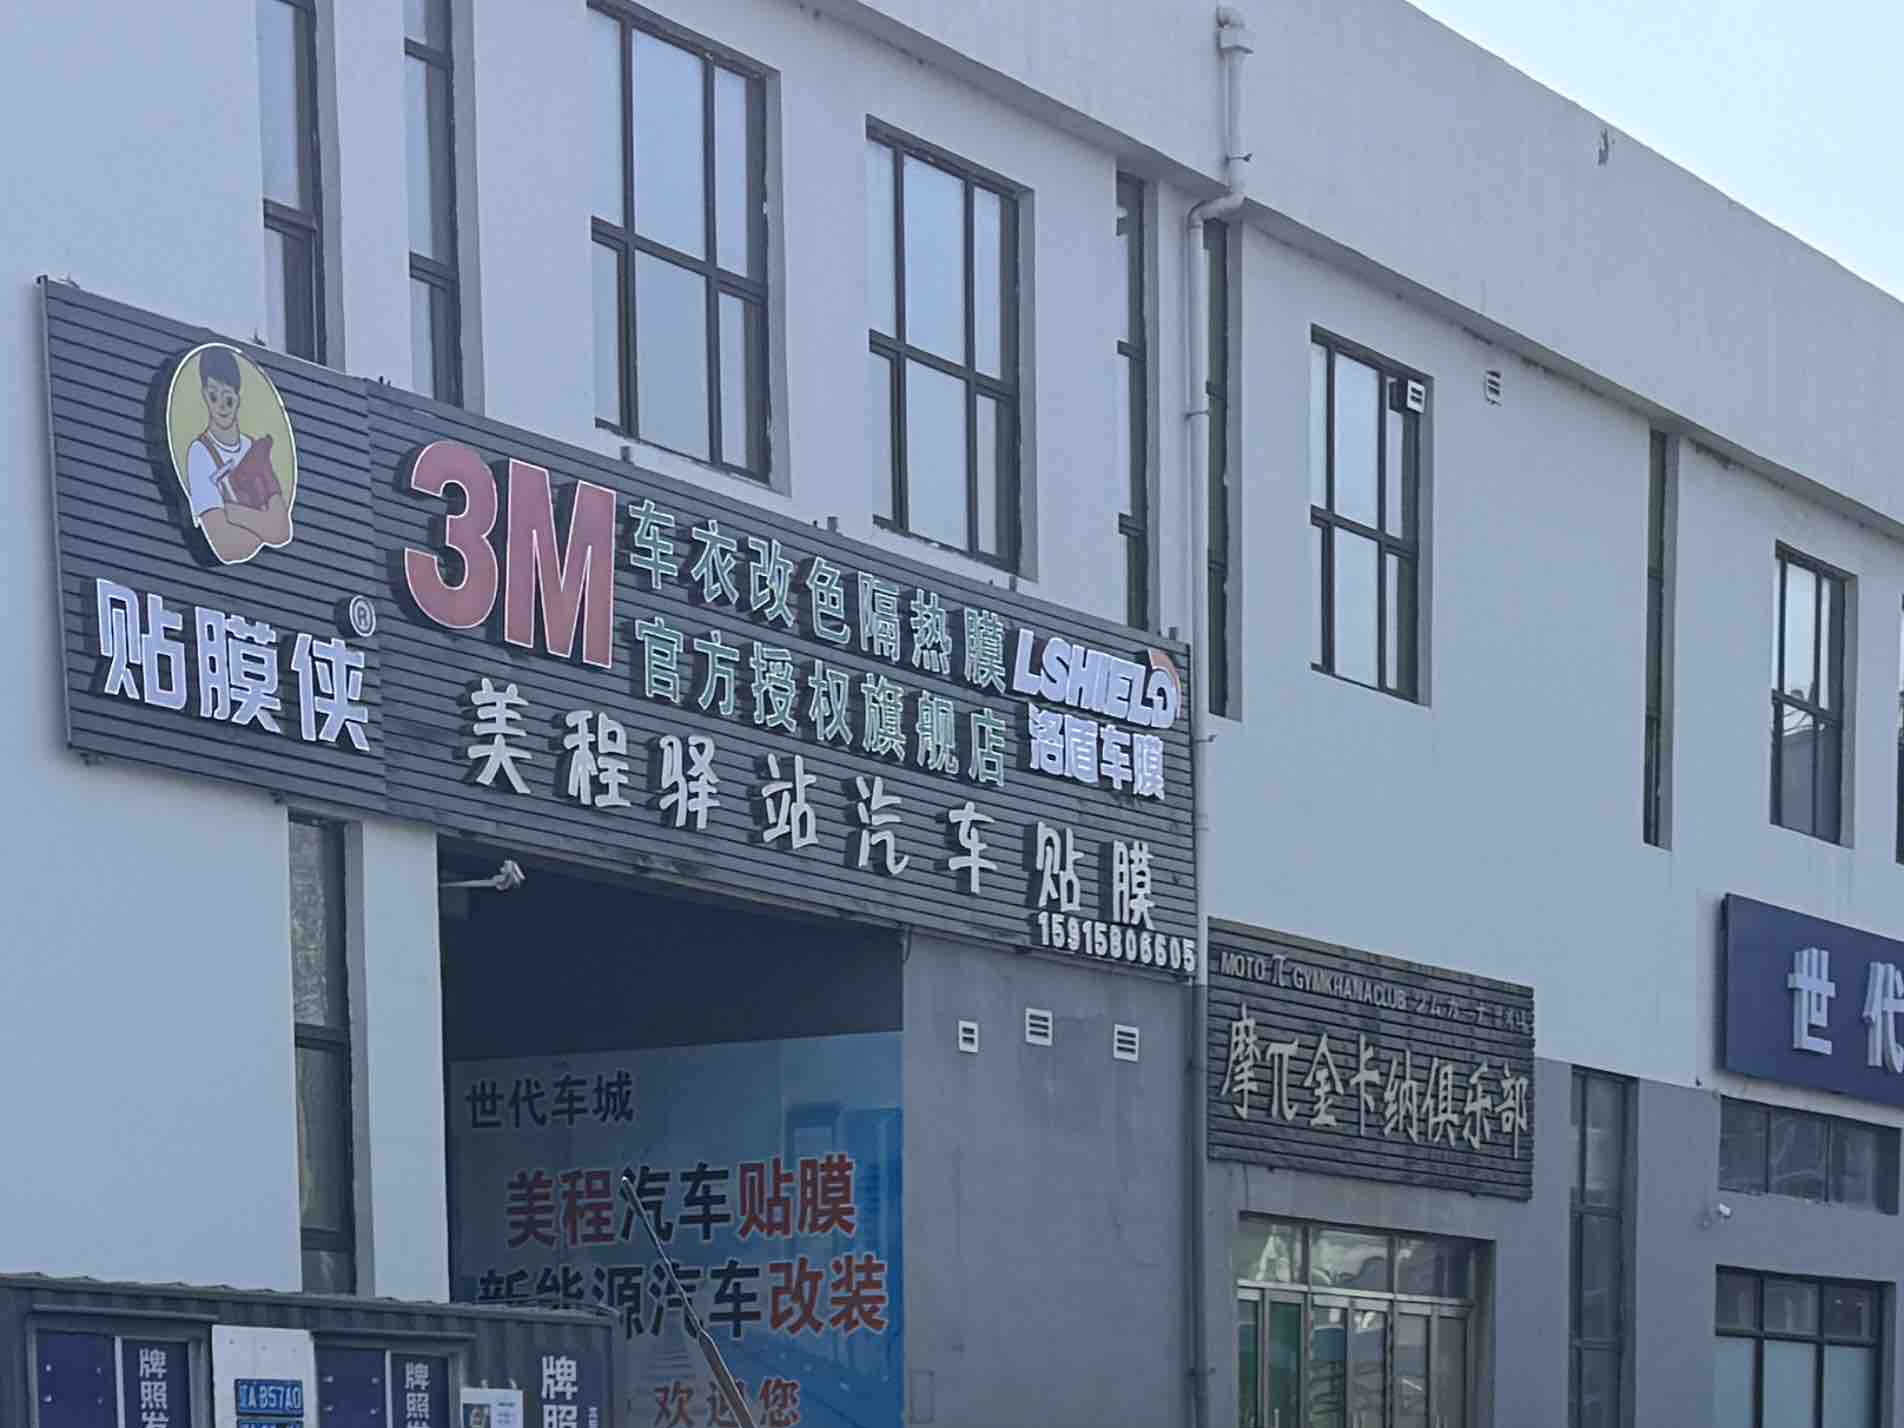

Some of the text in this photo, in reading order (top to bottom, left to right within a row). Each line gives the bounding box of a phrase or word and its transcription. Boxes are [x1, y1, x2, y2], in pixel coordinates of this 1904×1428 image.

[403, 440, 619, 669] 3M
[628, 499, 1007, 695] 车衣改色隔热膜
[96, 578, 371, 752] 贴膜侠
[636, 616, 1006, 787] 官方授权旗舰店
[465, 1070, 634, 1129] 世代车城
[506, 1153, 858, 1249] 美程汽车贴膜
